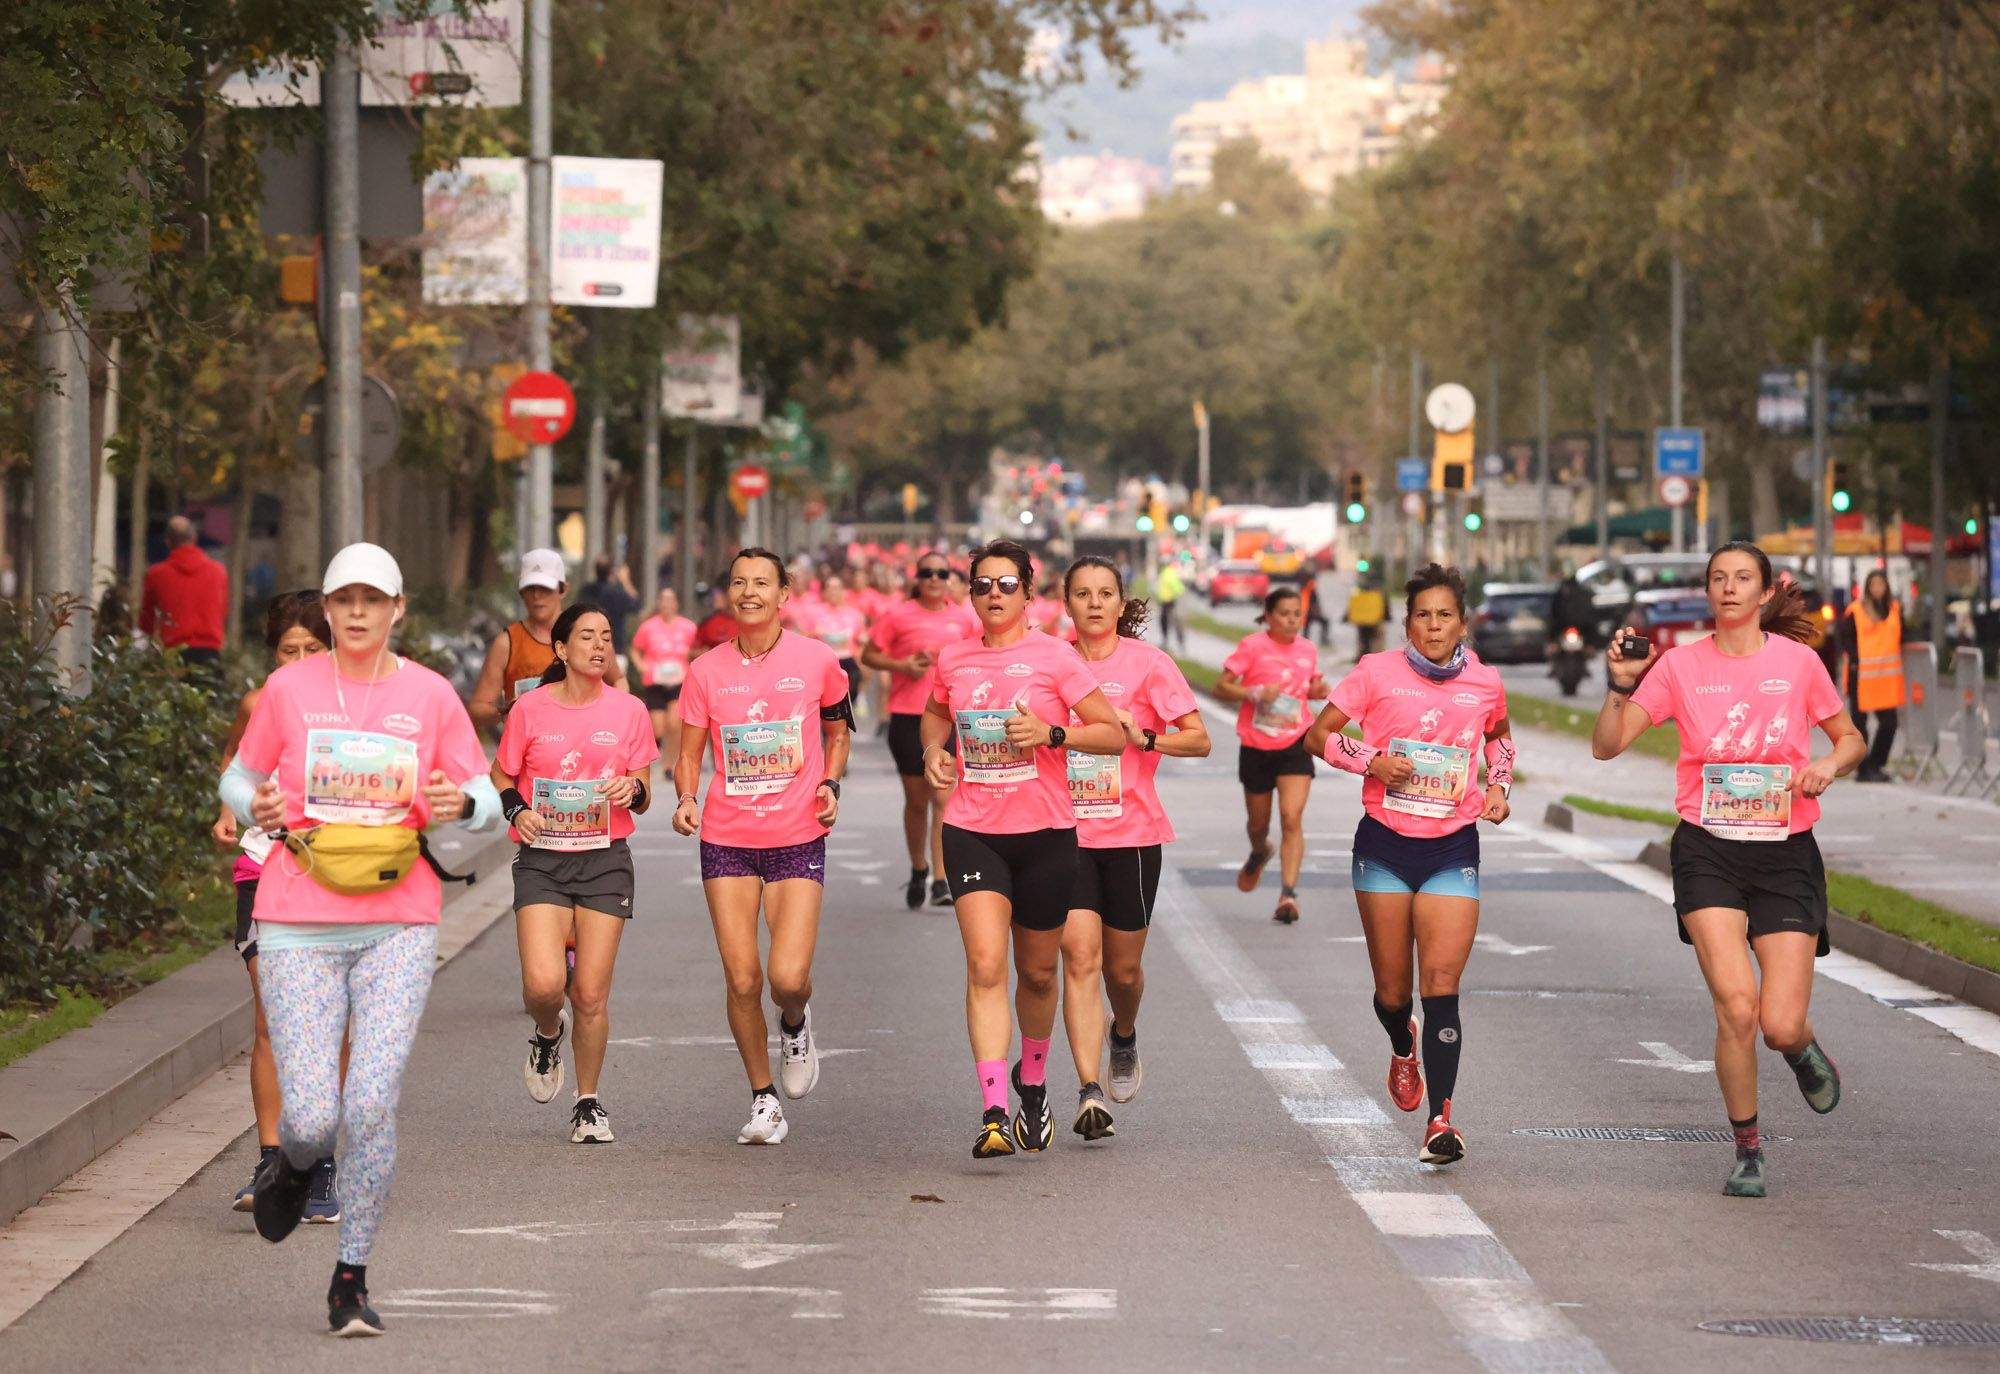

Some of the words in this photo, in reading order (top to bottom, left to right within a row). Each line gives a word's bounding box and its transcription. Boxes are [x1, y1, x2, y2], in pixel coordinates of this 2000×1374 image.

[1392, 687, 1426, 698] OYSHO
[1695, 684, 1731, 694] OYSHO
[303, 711, 350, 724] OYSHO
[745, 732, 777, 742] ASTURIANA
[980, 742, 1008, 754] 016
[748, 753, 778, 767] 016
[343, 772, 381, 788] 016
[1003, 770, 1029, 778] Santander
[1068, 779, 1095, 791] 016
[1411, 774, 1441, 789] 016
[555, 789, 585, 798] ASTURIANA
[734, 784, 758, 792] OYSHO
[1730, 798, 1763, 811] 016
[555, 811, 585, 823] 016
